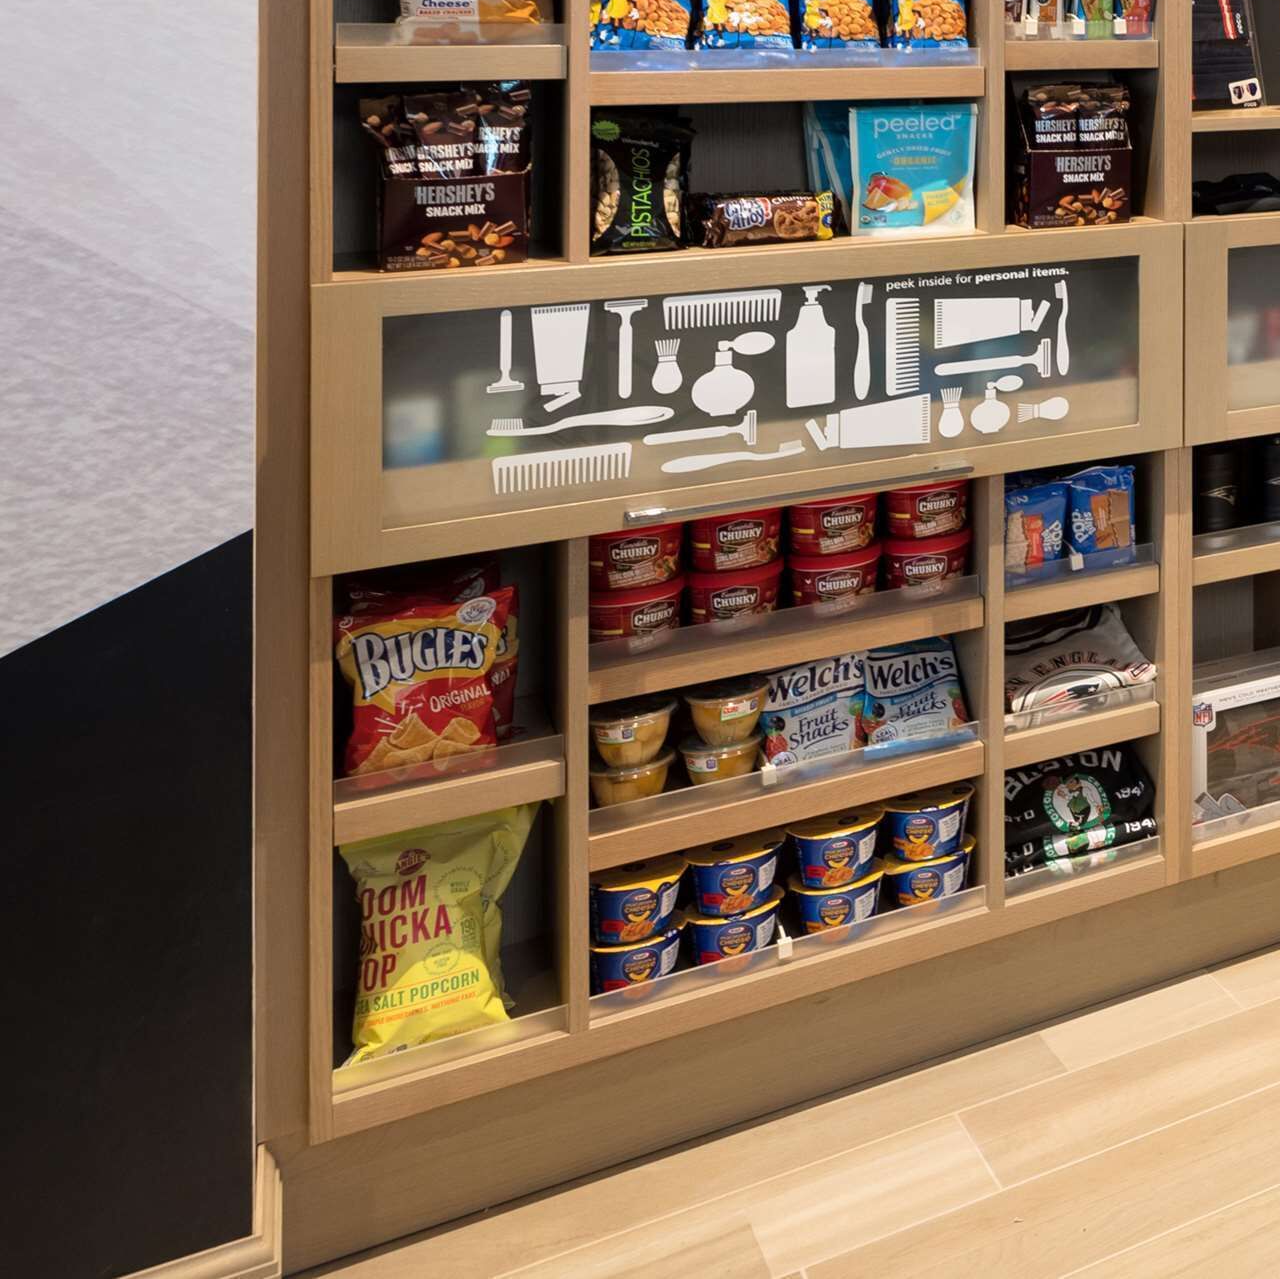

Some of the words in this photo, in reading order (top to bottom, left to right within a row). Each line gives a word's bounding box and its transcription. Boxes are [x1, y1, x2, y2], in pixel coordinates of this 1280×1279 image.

[1036, 133, 1062, 144] SNACK
[1079, 131, 1104, 142] SNACK
[416, 142, 474, 160] HERSHEY'S
[418, 160, 454, 173] SNACK
[454, 158, 474, 171] MIX
[1056, 155, 1112, 173] HERSHEY'S
[1063, 173, 1090, 184] SNACK
[1090, 171, 1105, 182] MIX
[415, 182, 495, 205] HERSHEY'S
[630, 147, 652, 238] PISTACHIOS
[425, 204, 463, 218] SNACK
[464, 202, 486, 215] MIX
[886, 278, 916, 293] peek
[917, 275, 953, 288] inside
[954, 273, 973, 285] for
[975, 268, 1030, 285] personal
[1032, 266, 1070, 278] items.
[919, 496, 957, 513] CHUNKY
[823, 511, 863, 528] CHUNKY
[719, 526, 762, 542] CHUNKY
[611, 544, 657, 561] CHUNKY
[905, 561, 945, 576] CHUNKY
[818, 577, 860, 592] CHUNKY
[713, 592, 757, 609] CHUNKY
[634, 606, 674, 626] CHUNKY
[352, 627, 490, 701] BUGLES
[868, 655, 954, 691] Welch's
[768, 654, 864, 703] Welch's
[429, 682, 492, 713] ORIGINAL
[798, 707, 839, 734] Fruit
[789, 717, 850, 751] Snacks
[356, 874, 427, 921] OOM
[373, 990, 404, 1012] SALT
[409, 969, 480, 1004] POPCORN
